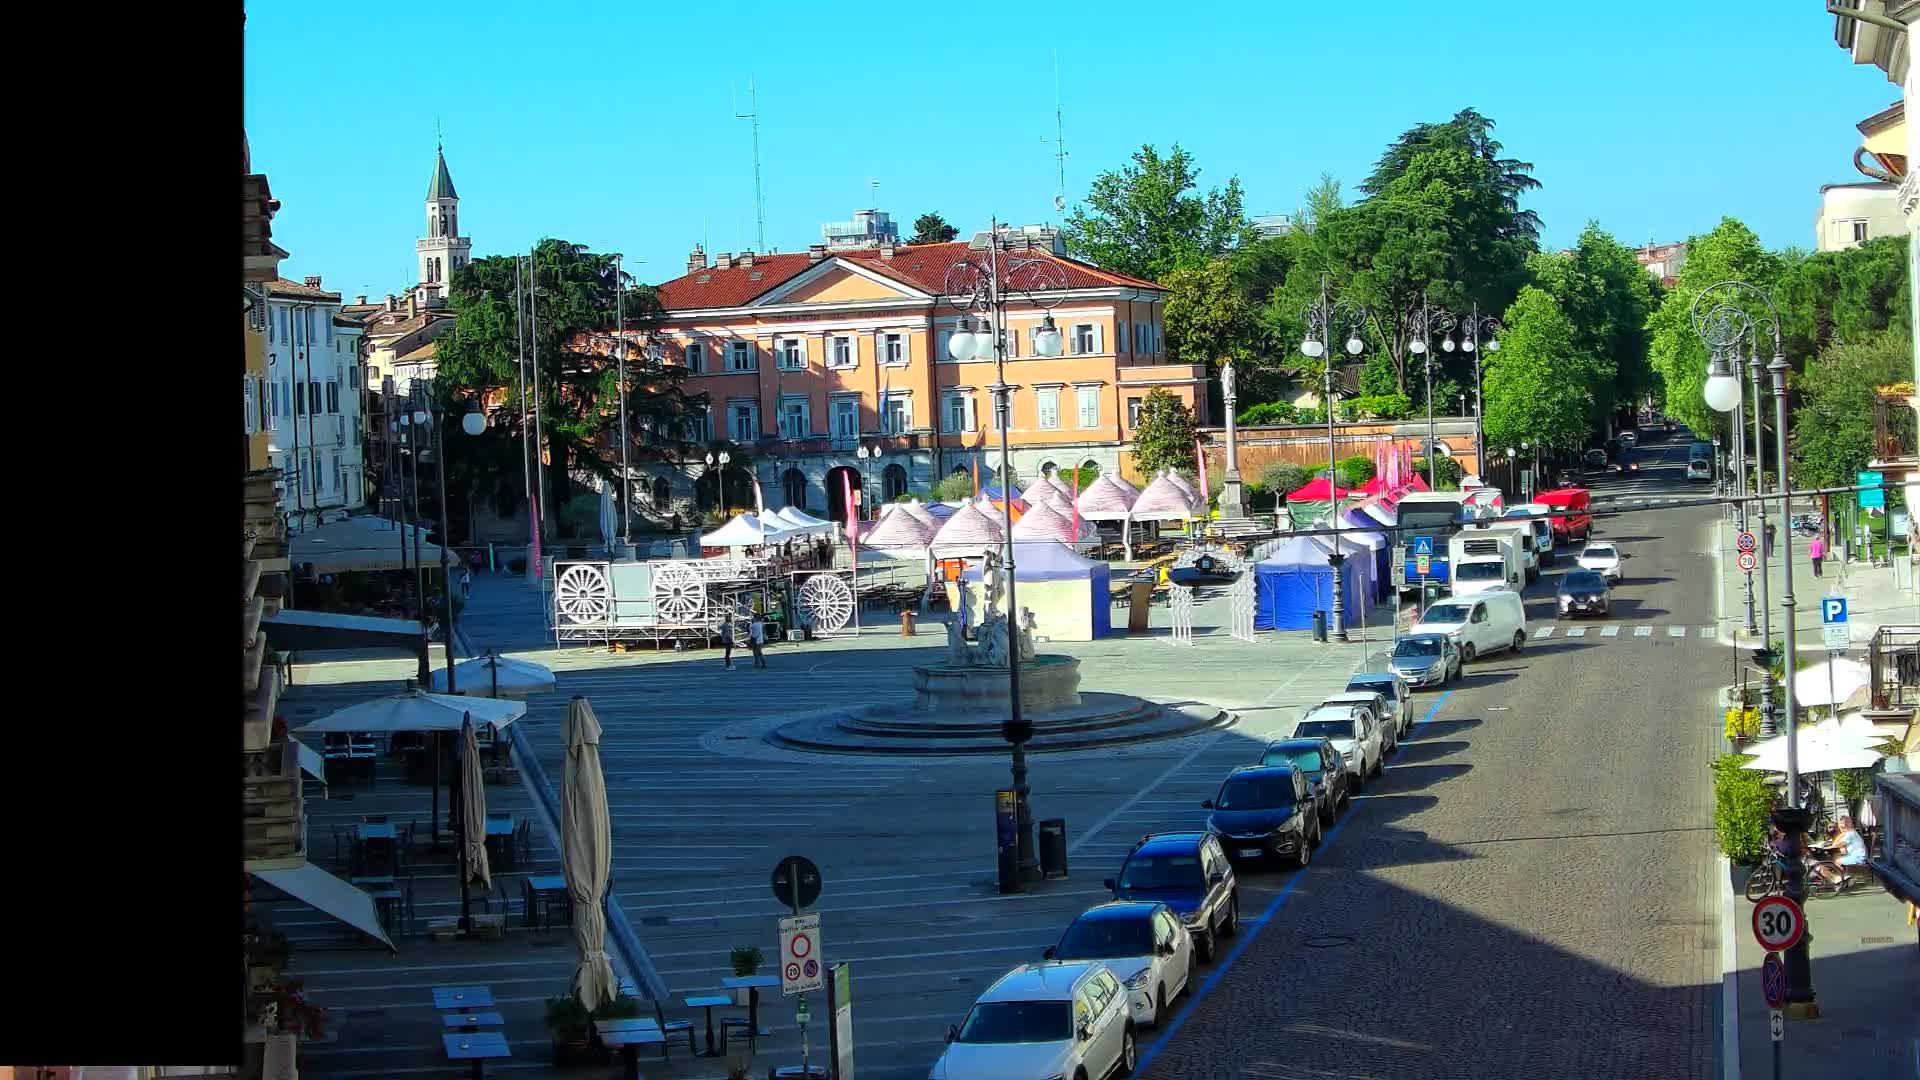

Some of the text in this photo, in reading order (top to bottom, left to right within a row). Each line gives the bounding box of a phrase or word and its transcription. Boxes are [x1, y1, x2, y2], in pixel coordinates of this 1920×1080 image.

[1743, 557, 1752, 566] 20
[1828, 601, 1842, 621] P
[1762, 911, 1791, 936] 30
